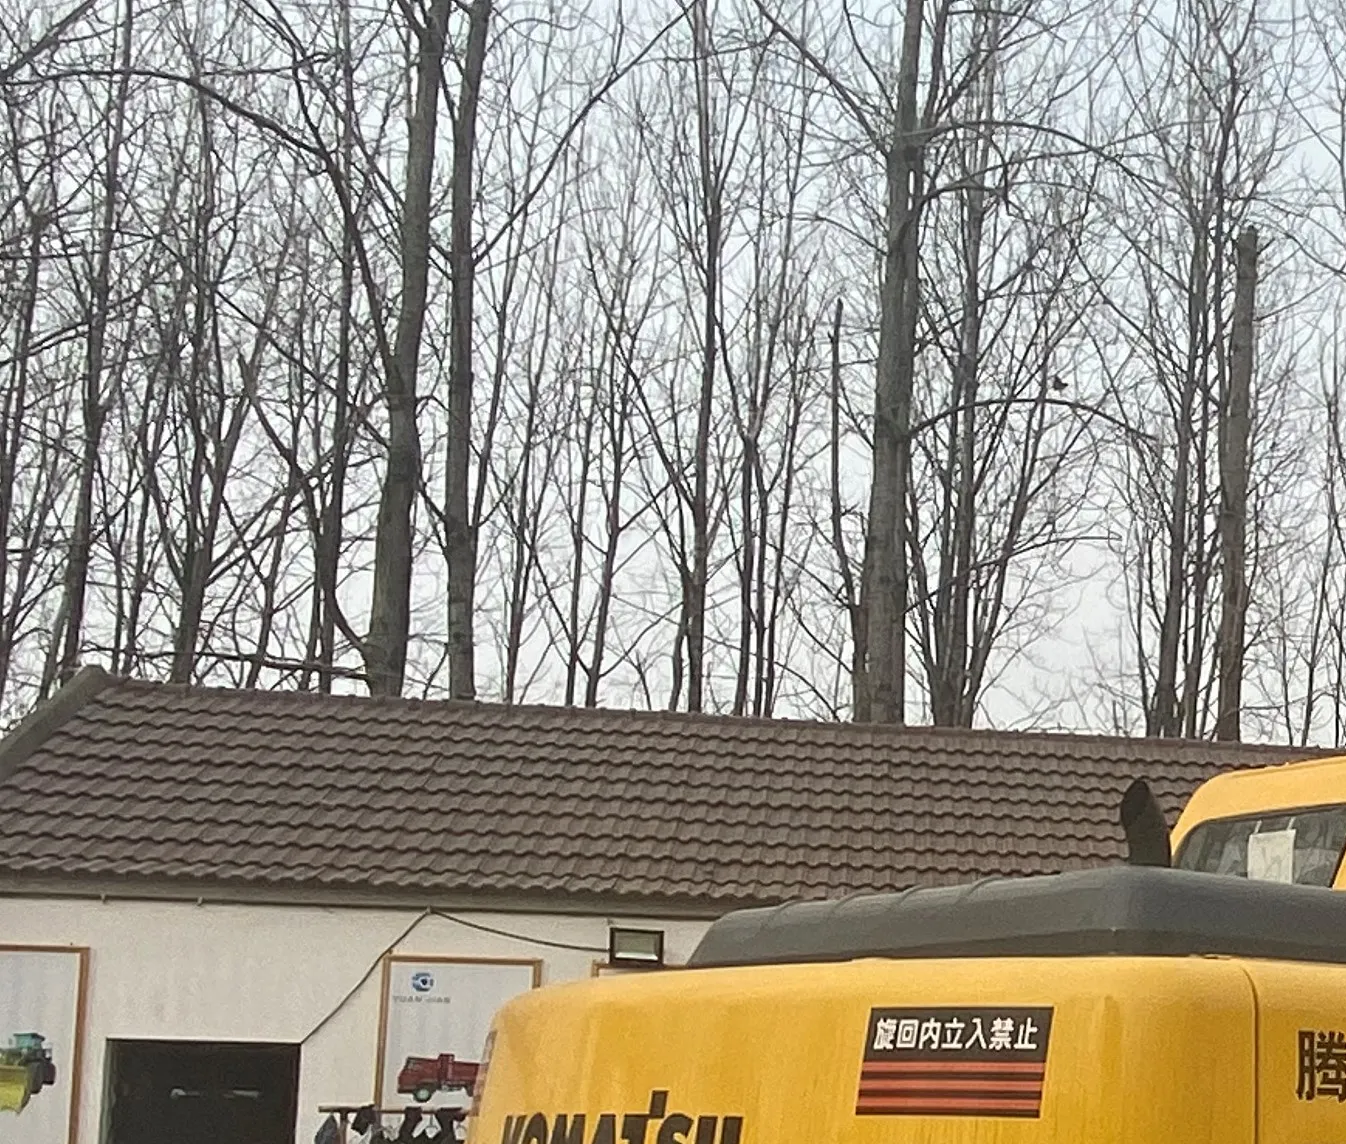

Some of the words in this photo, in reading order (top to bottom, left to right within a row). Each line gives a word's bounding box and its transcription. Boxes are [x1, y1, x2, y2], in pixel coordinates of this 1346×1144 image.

[873, 1016, 1039, 1051] 旋回内立入禁止
